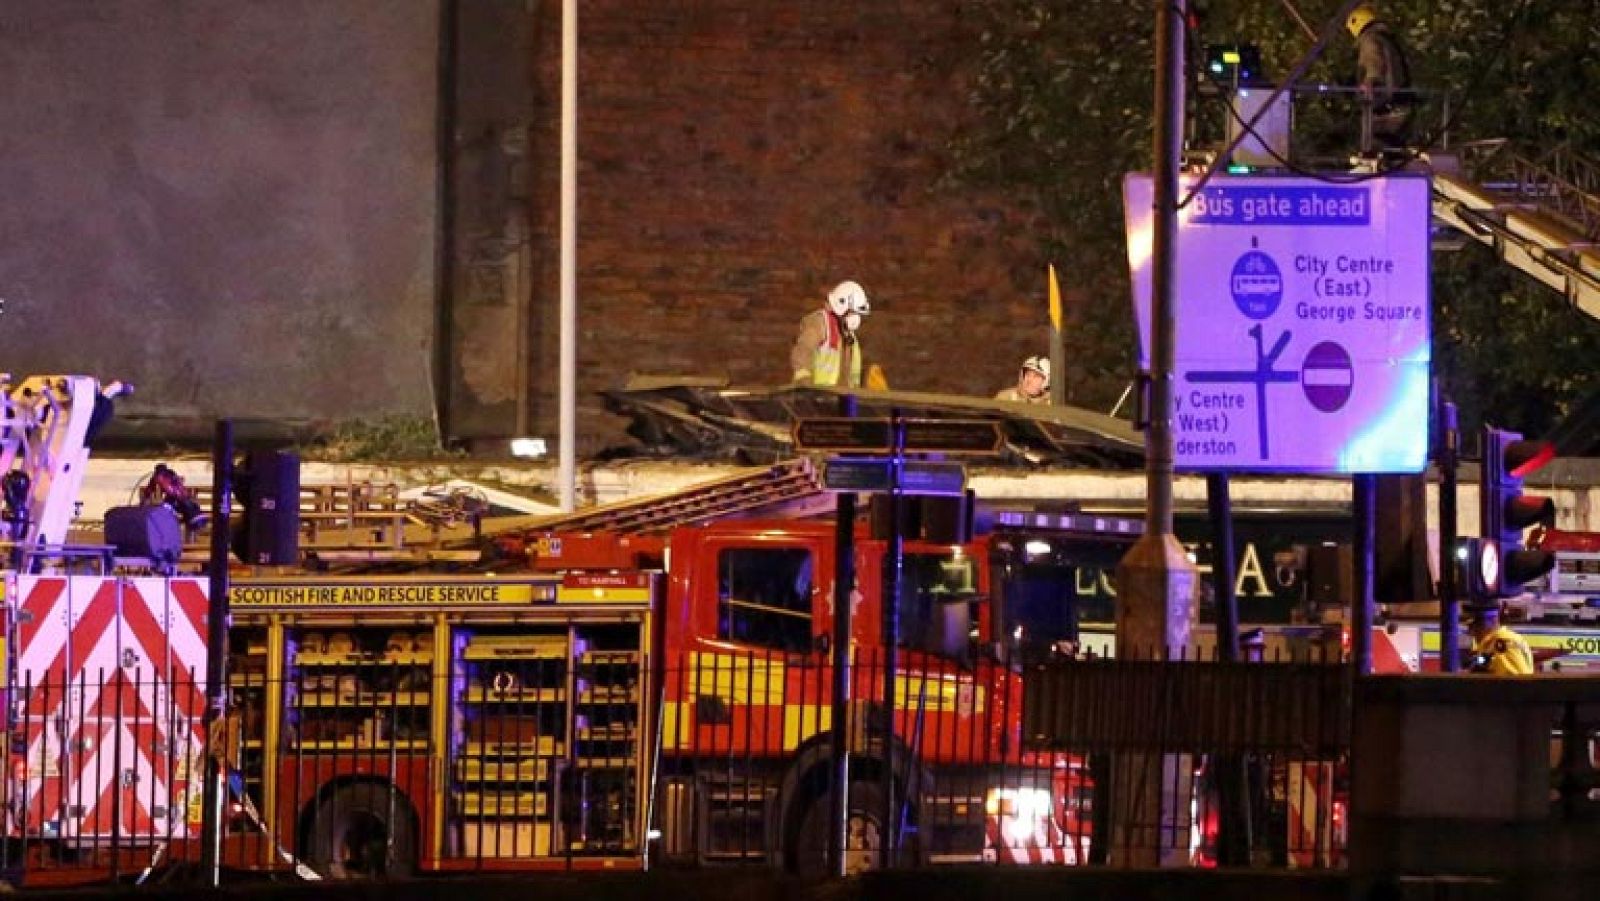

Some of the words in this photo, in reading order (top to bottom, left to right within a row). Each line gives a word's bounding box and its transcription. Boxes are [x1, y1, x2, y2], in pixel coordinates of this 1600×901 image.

[1193, 192, 1234, 217] Bus
[1242, 193, 1291, 222] gate
[1299, 193, 1364, 217] ahead
[1295, 255, 1328, 277] City
[1336, 255, 1394, 273] Centre
[1314, 277, 1371, 298] (East)
[1296, 302, 1355, 323] George
[1363, 302, 1422, 321] Square
[1190, 390, 1245, 409] Centre
[1177, 412, 1228, 434] West)
[1176, 439, 1236, 455] derston
[233, 587, 304, 604] SCOTTISH
[307, 587, 338, 604] FIRE
[342, 587, 375, 603] AND
[378, 587, 434, 602] RESCUE
[438, 587, 499, 602] SERVICE
